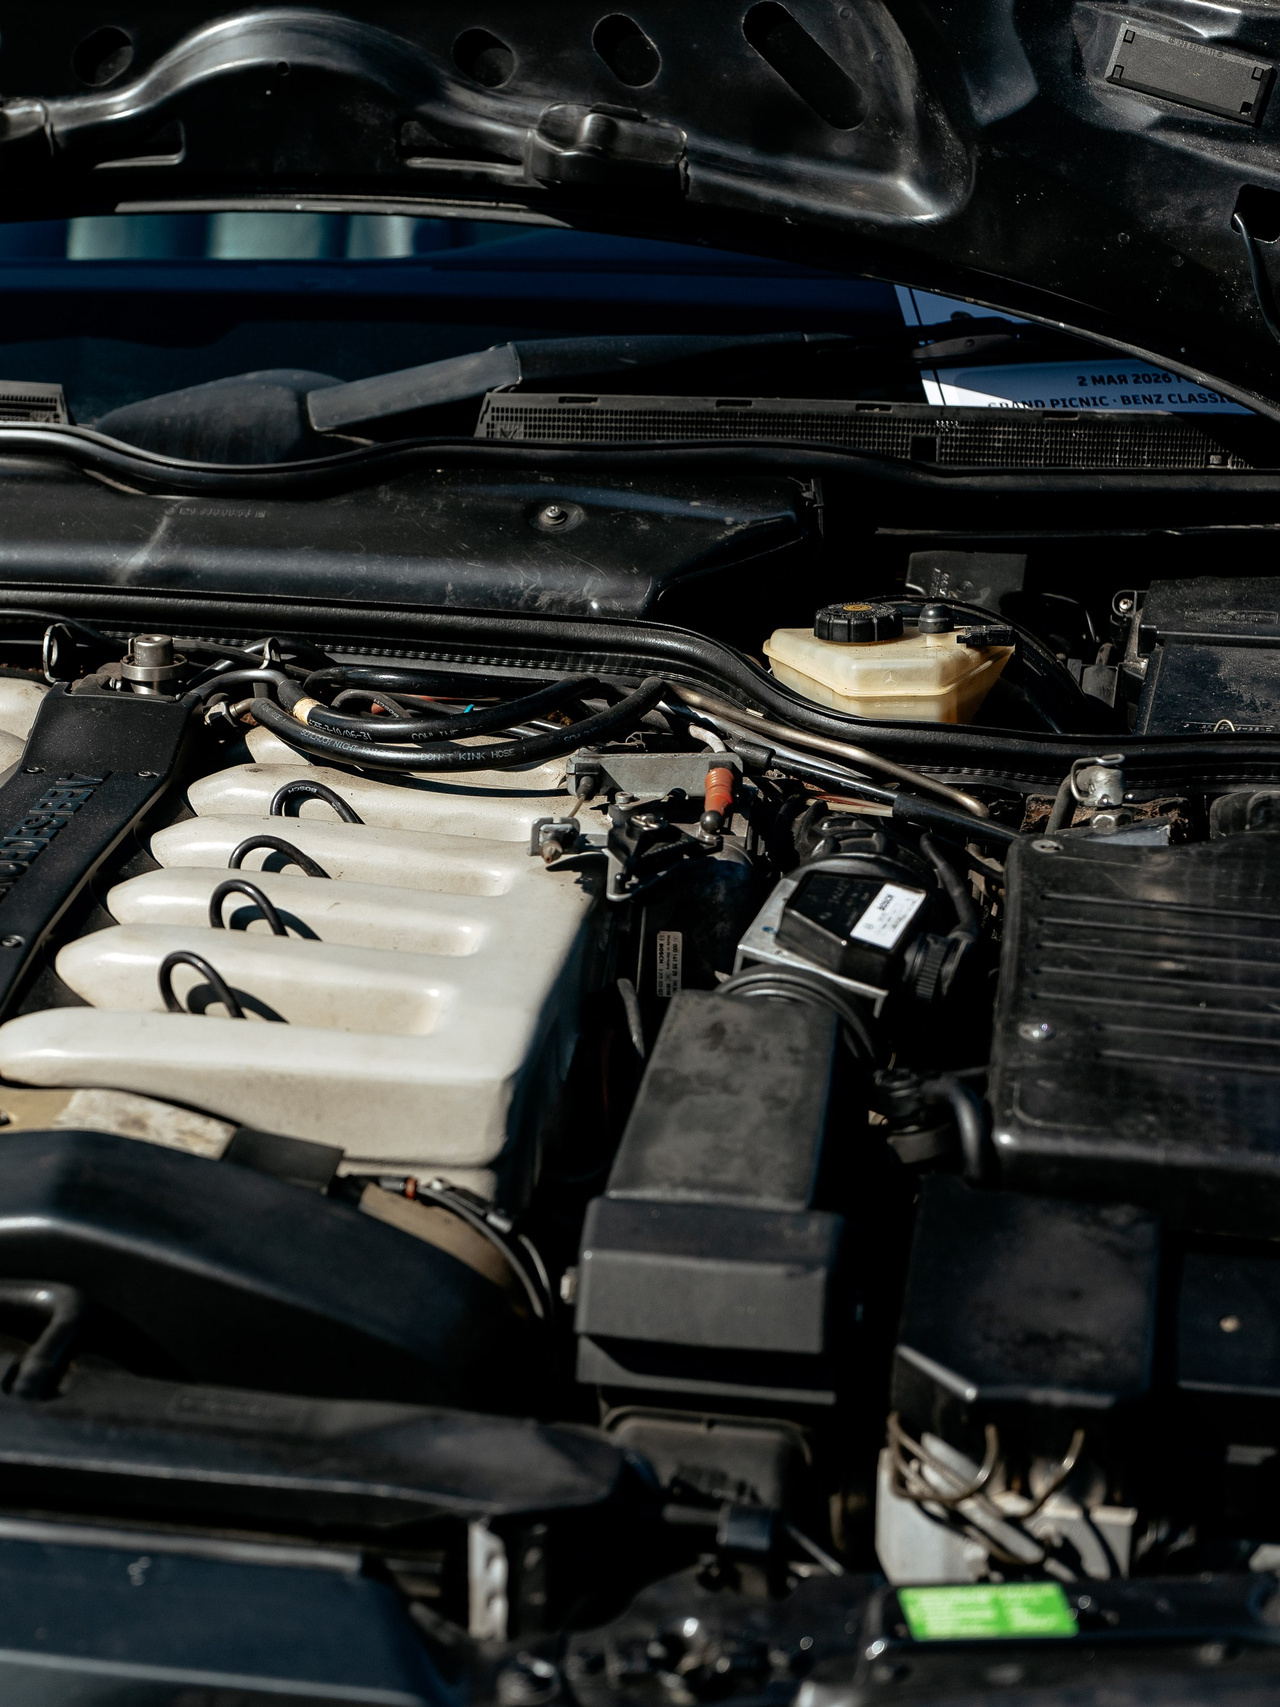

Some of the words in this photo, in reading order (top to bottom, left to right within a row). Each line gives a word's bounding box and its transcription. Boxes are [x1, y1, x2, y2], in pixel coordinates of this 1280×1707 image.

[1077, 376, 1087, 387] 2
[1131, 373, 1171, 385] 2026
[1051, 395, 1110, 408] PICNIC
[1122, 394, 1165, 405] BENZ
[458, 752, 485, 761] KINK
[491, 748, 516, 759] HOSE
[287, 785, 317, 794] BOSCH
